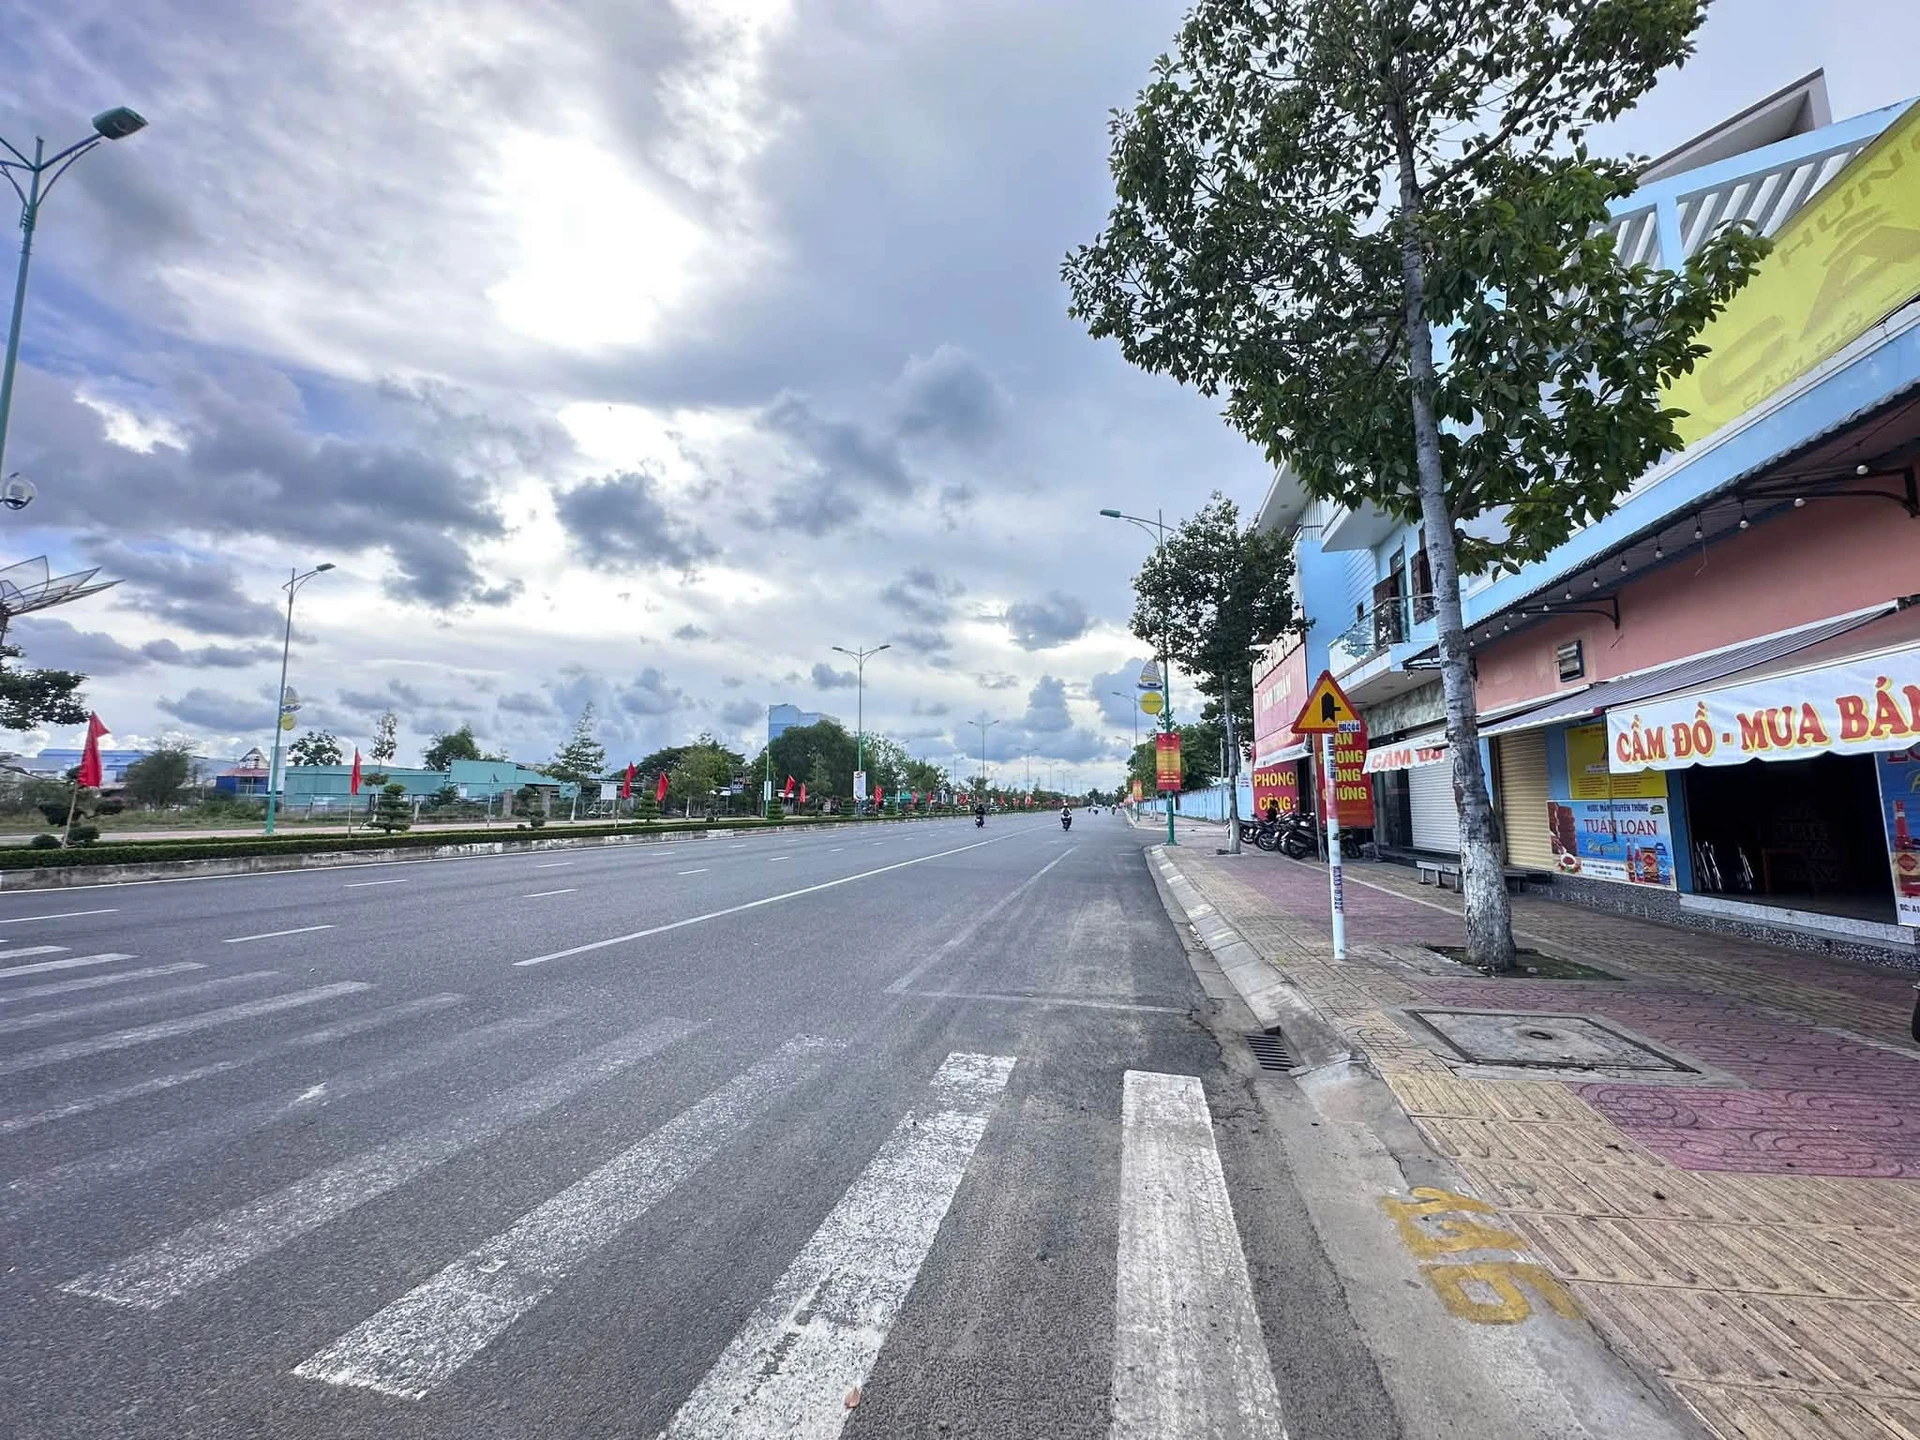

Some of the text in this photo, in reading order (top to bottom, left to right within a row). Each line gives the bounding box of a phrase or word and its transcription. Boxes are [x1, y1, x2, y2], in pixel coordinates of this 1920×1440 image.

[1616, 714, 1668, 763] CẦM
[1672, 701, 1715, 757] ĐỒ
[1736, 702, 1829, 752] MUA
[1254, 769, 1295, 787] PHÒNG
[1620, 819, 1657, 836] LOAN
